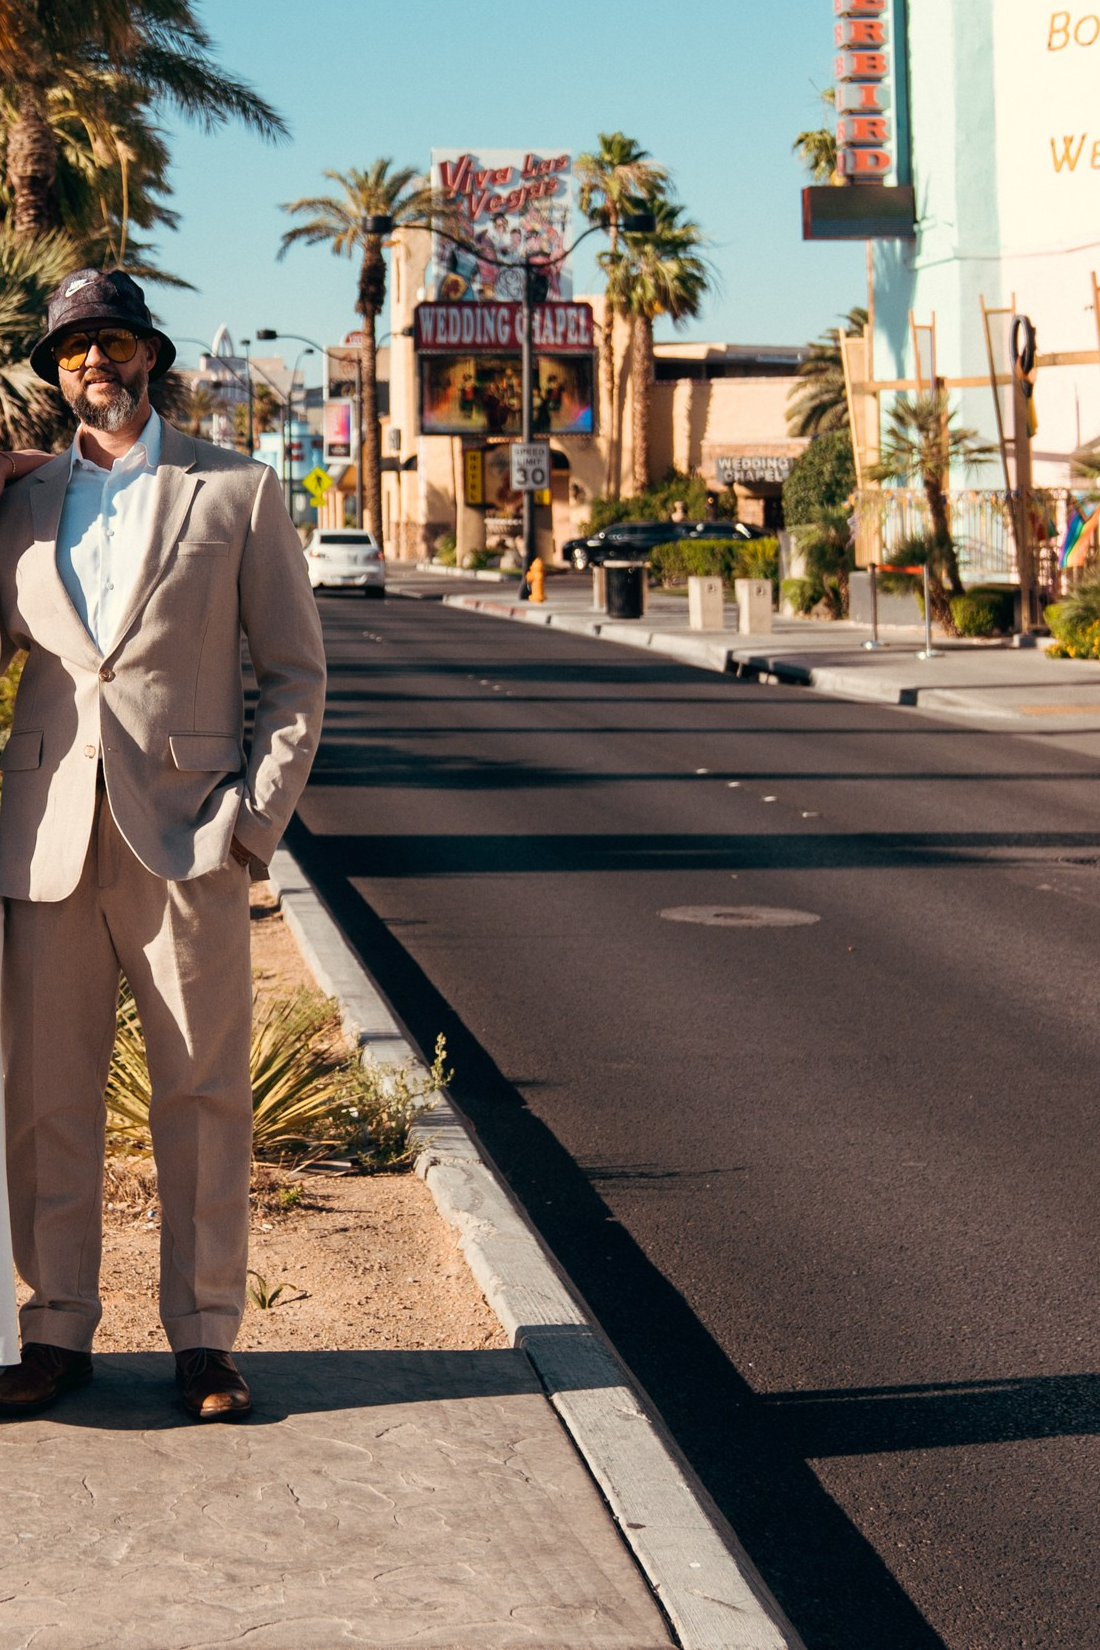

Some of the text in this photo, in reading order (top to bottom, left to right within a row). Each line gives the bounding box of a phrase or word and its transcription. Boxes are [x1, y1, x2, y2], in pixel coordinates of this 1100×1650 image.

[440, 154, 570, 199] Viva Las
[468, 177, 559, 221] Vegas
[418, 307, 510, 344] WEDDING
[516, 468, 545, 485] 30
[719, 457, 790, 470] WEDDING
[724, 469, 784, 482] CHAPEL
